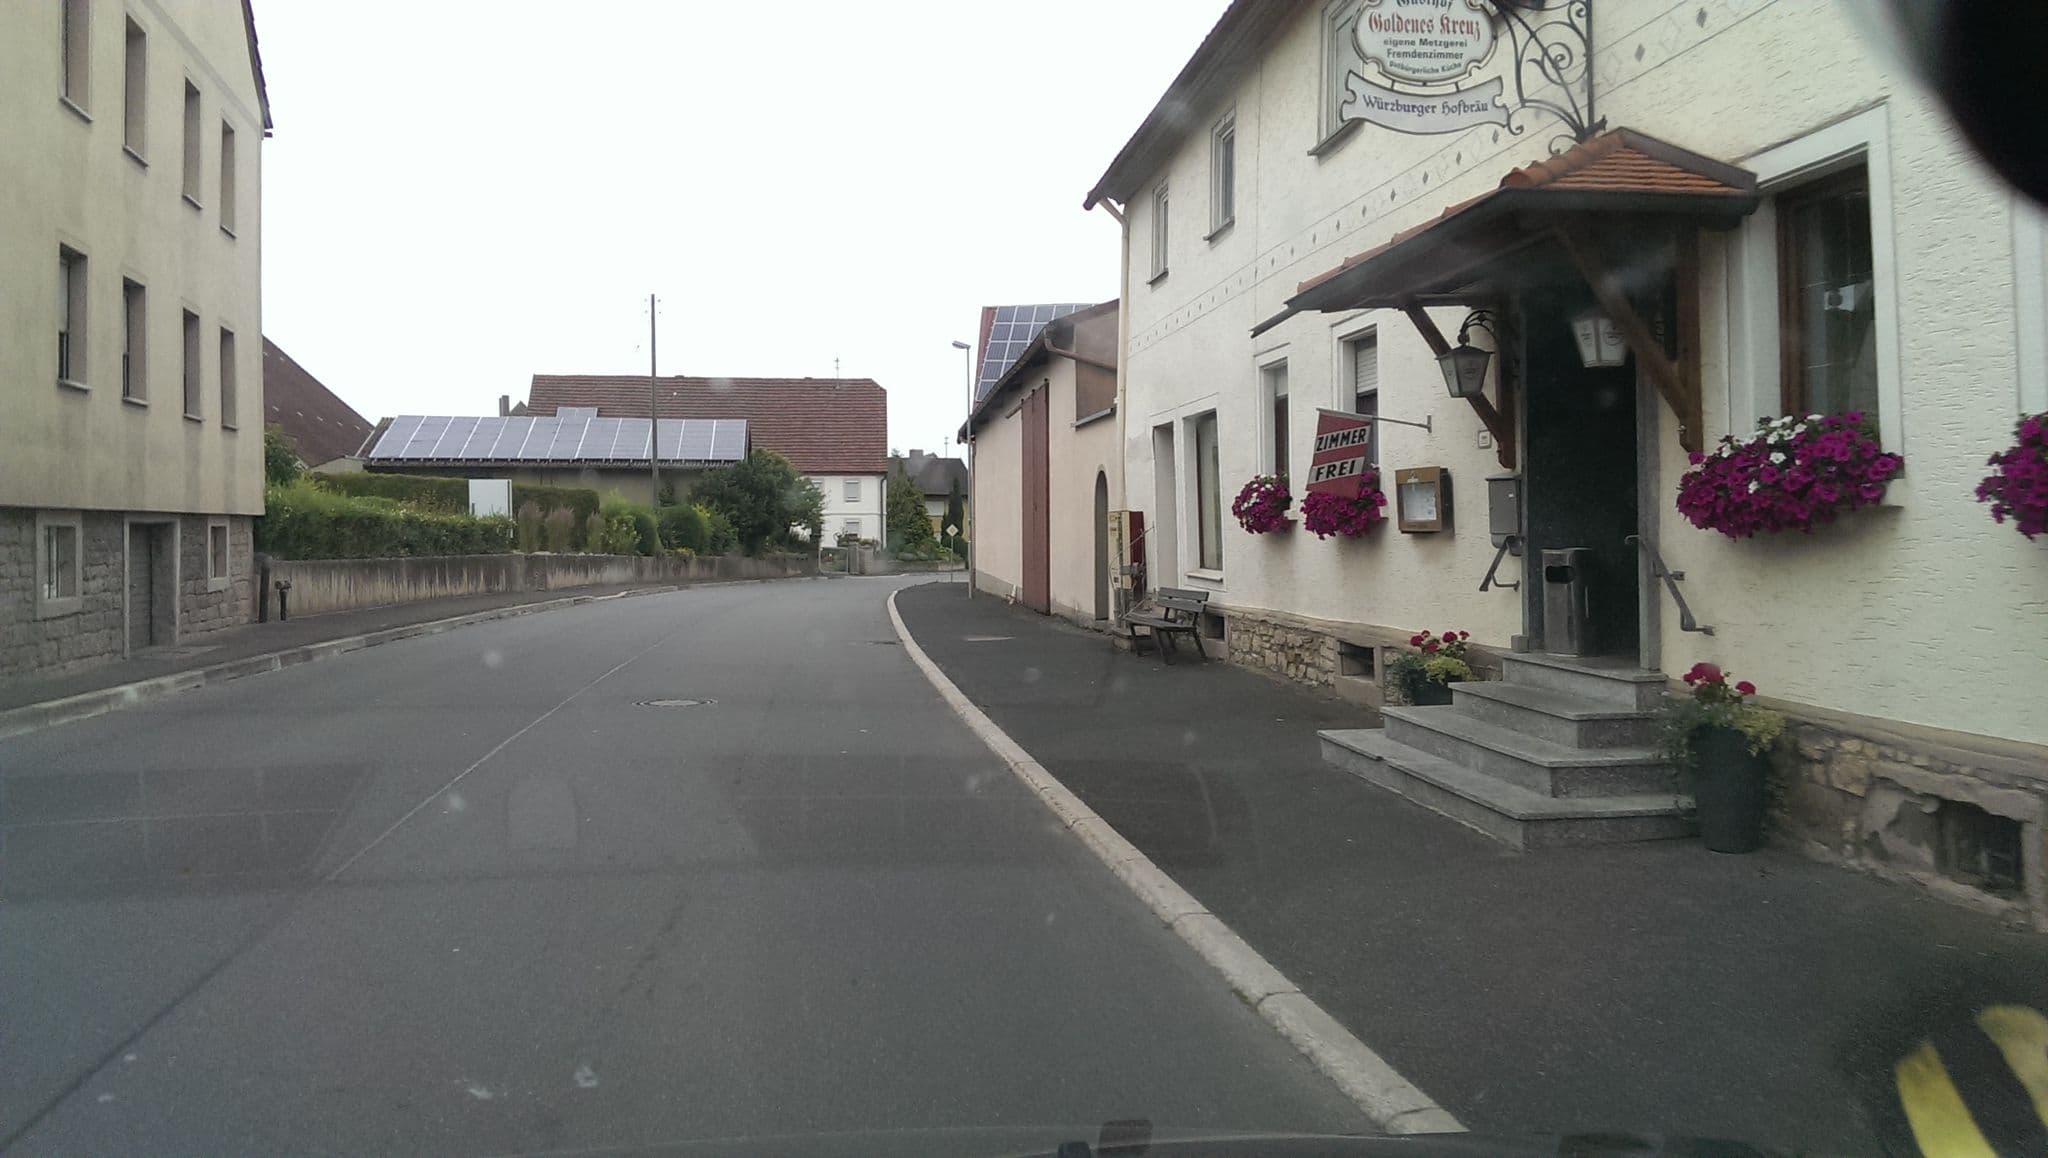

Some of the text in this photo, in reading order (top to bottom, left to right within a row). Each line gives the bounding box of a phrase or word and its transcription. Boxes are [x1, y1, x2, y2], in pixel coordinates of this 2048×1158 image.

[1368, 11, 1481, 41] Goldenes Kreuz
[1383, 38, 1468, 48] eigene Metzgerei
[1386, 49, 1464, 59] Fremdenzimmer
[1441, 62, 1462, 72] Küche
[1362, 94, 1489, 117] Würzburger Hofbräu
[1316, 428, 1367, 452] ZIMMER
[1315, 460, 1356, 482] FREI
